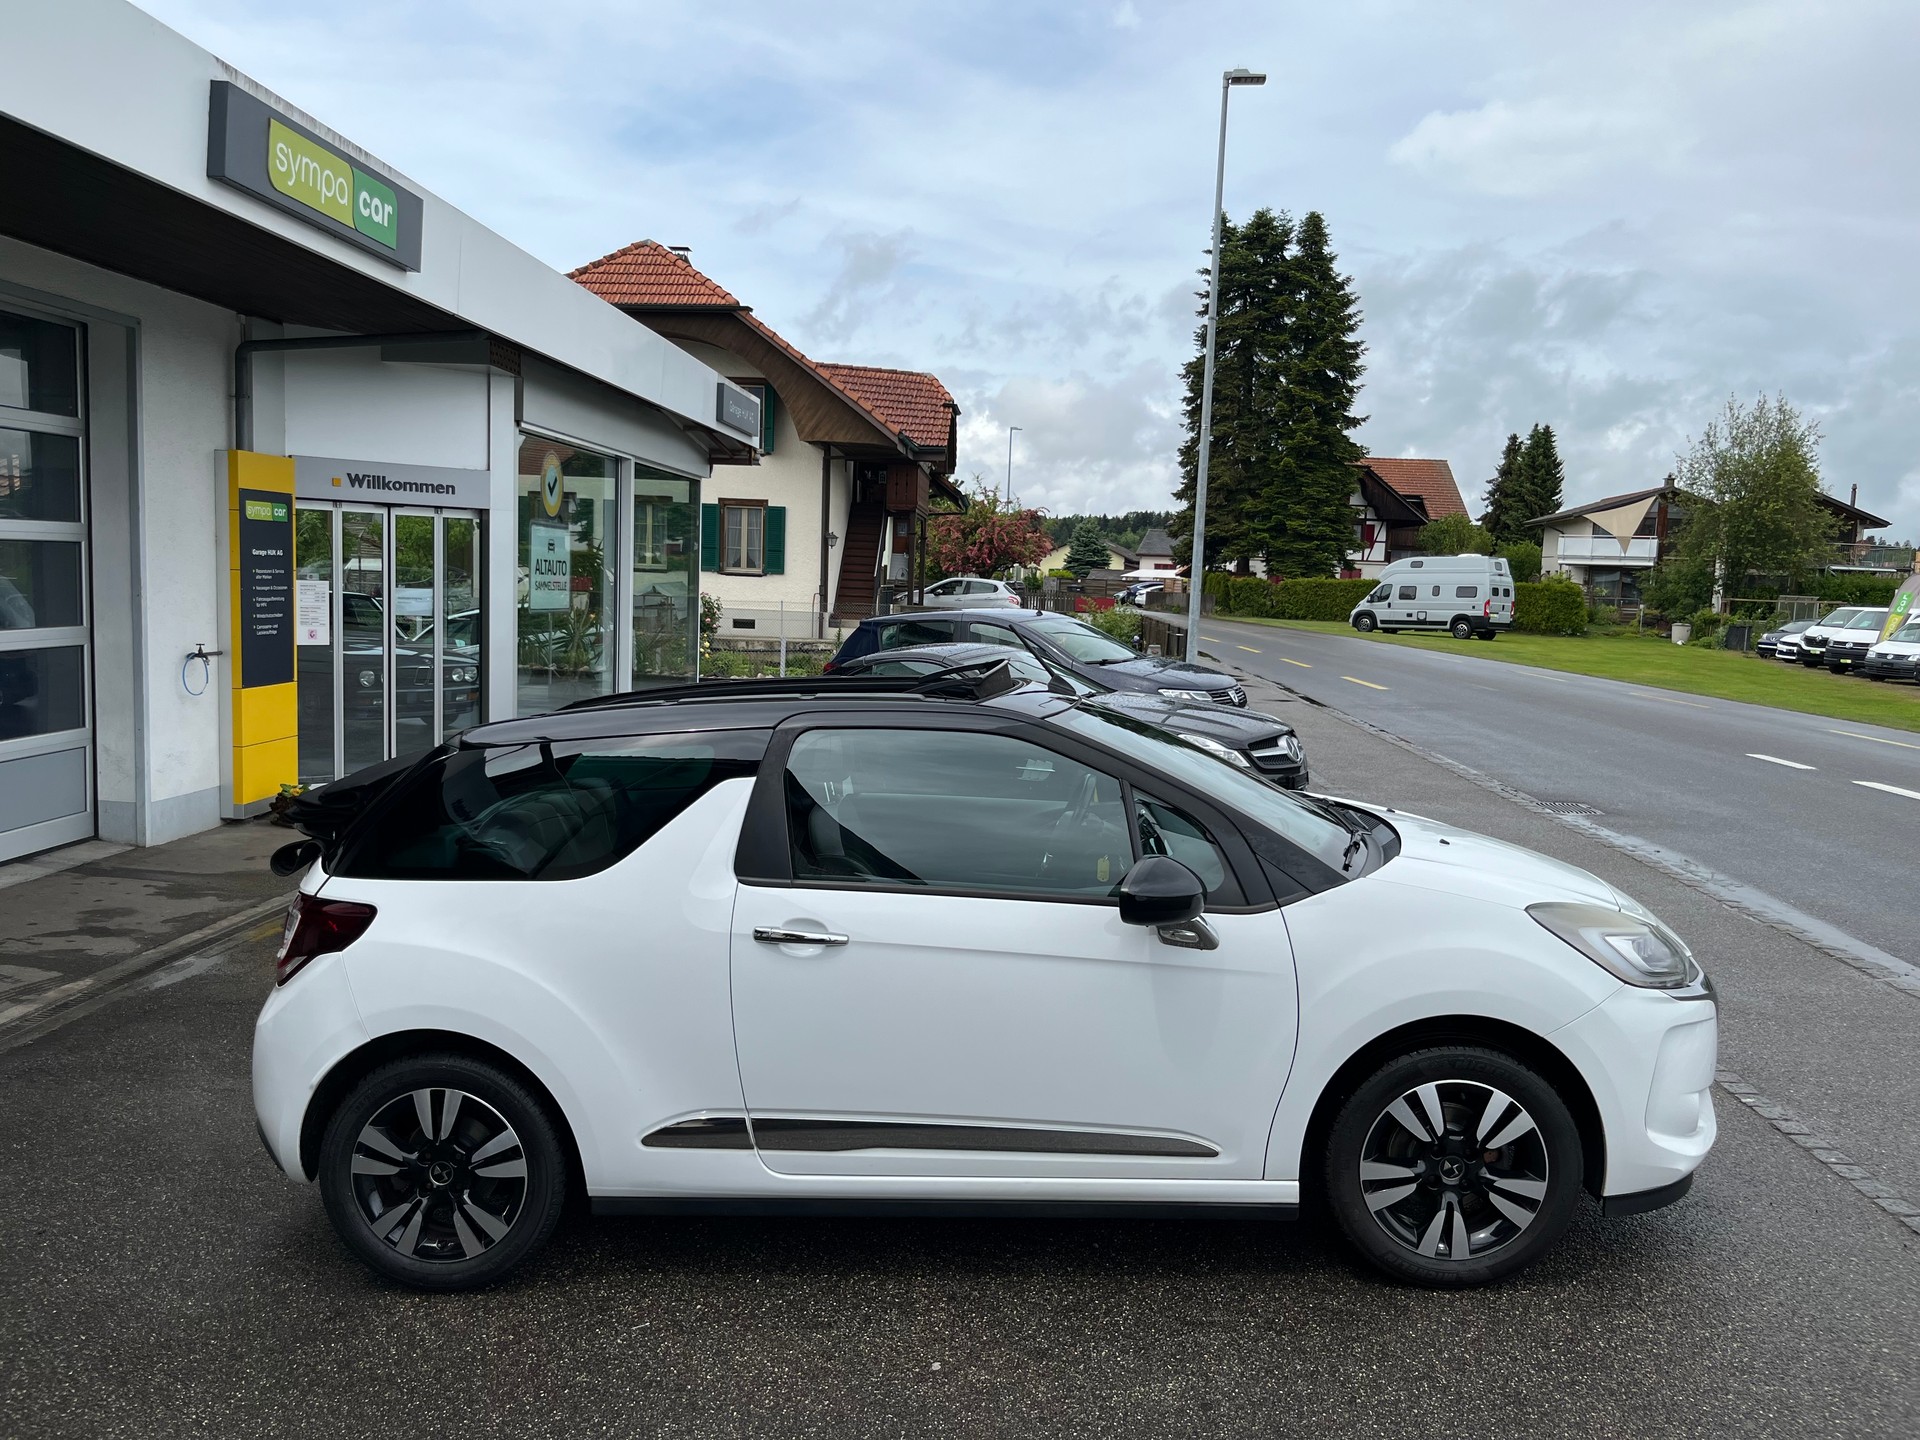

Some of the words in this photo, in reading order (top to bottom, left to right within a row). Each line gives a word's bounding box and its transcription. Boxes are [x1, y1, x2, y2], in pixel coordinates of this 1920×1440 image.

[275, 142, 349, 206] sympa
[359, 190, 393, 228] car
[346, 472, 456, 495] Willkommen
[247, 505, 272, 517] sympa
[273, 507, 287, 517] car
[252, 548, 267, 557] Garage
[534, 558, 568, 577] ALTAUTO
[534, 580, 568, 592] SAMMELSTELLE
[1896, 594, 1908, 613] car
